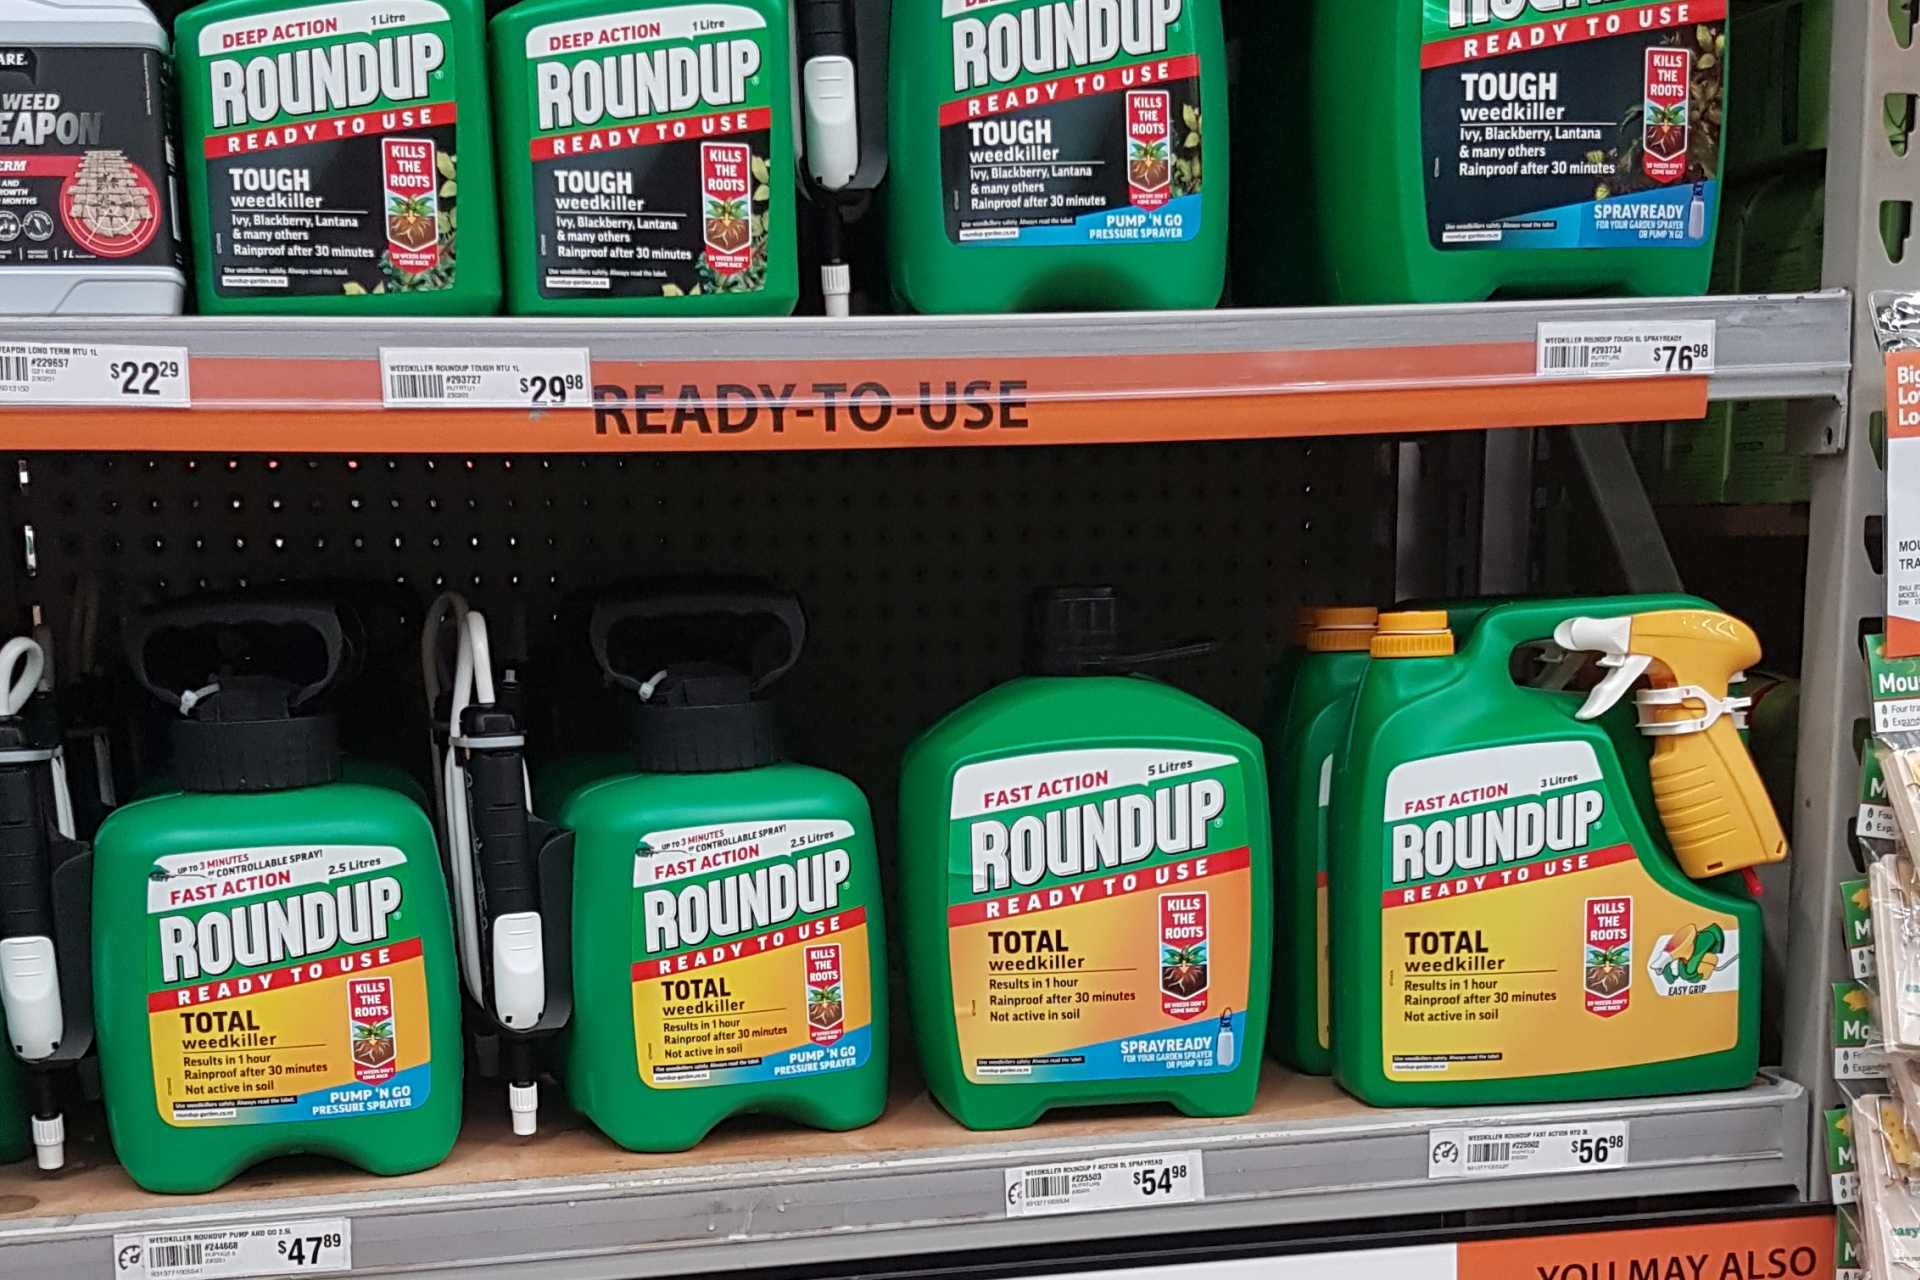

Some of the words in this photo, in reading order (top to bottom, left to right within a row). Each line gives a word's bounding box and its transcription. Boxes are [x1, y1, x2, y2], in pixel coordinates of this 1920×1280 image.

[371, 16, 376, 25] 1
[379, 14, 405, 24] Litre
[693, 22, 698, 31] 1
[700, 20, 725, 31] Litre
[223, 29, 268, 48] DEEP
[272, 18, 337, 41] ACTION
[550, 32, 593, 51] DEEP
[598, 22, 660, 44] ACTION
[1464, 23, 1567, 58] READY
[1587, 15, 1620, 36] TO
[1639, 5, 1689, 28] USE
[953, 0, 1181, 92] ROUNDUP
[1654, 55, 1682, 68] KILLS
[210, 33, 444, 128] ROUNDUP
[1658, 70, 1678, 82] THE
[537, 39, 760, 131] ROUNDUP
[968, 82, 1058, 116] READY
[1075, 75, 1105, 94] TO
[1122, 62, 1168, 85] USE
[1461, 72, 1556, 101] TOUGH
[1650, 84, 1684, 96] ROOTS
[2, 94, 60, 110] WEED
[1133, 97, 1162, 108] KILLS
[1138, 110, 1158, 121] THE
[1461, 102, 1564, 120] weedkiller
[228, 124, 317, 153] READY
[334, 118, 365, 136] TO
[383, 109, 431, 128] USE
[554, 129, 640, 154] READY
[656, 122, 685, 140] TO
[702, 113, 748, 133] USE
[969, 120, 1051, 146] TOUGH
[1132, 123, 1165, 134] ROOTS
[391, 145, 426, 159] KILLS
[710, 150, 741, 163] KILLS
[970, 147, 1060, 163] weedkiller
[397, 160, 421, 173] THE
[715, 164, 737, 177] THE
[229, 169, 310, 192] TOUGH
[390, 175, 430, 188] ROOTS
[554, 170, 632, 195] TOUGH
[708, 178, 745, 191] ROOTS
[2, 197, 38, 205] MONTHS
[231, 193, 323, 208] weedkiller
[556, 196, 645, 211] weedkiller
[1594, 205, 1684, 219] SPRAYREADY
[232, 215, 251, 227] Ivy,
[253, 215, 314, 228] Blackberry,
[316, 216, 358, 227] Lantana
[1107, 214, 1146, 227] PUMP
[1165, 214, 1183, 225] GO
[233, 230, 241, 239] &
[244, 232, 273, 242] many
[275, 230, 309, 240] others
[1089, 229, 1138, 239] PRESSURE
[1140, 227, 1182, 238] SPRAYER
[234, 245, 285, 257] Rainproof
[288, 246, 312, 256] after
[315, 246, 329, 256] 30
[332, 247, 374, 258] minutes
[594, 380, 1029, 435] READY-TO-USE
[1879, 672, 1920, 693] Mou
[1148, 765, 1155, 776] 5
[1159, 759, 1193, 773] Litres
[1540, 779, 1547, 788] 3
[1550, 774, 1578, 786] Litres
[984, 785, 1032, 809] FAST
[1038, 770, 1108, 798] ACTION
[1404, 796, 1445, 815] FAST
[1449, 783, 1508, 807] ACTION
[790, 837, 805, 848] 2.5
[808, 831, 834, 844] Litres
[971, 779, 1225, 894] ROUNDUP
[1393, 790, 1603, 884] ROUNDUP
[200, 861, 205, 870] 3
[207, 854, 249, 869] MINUTES
[217, 857, 287, 878] CONTROLLABLE
[290, 850, 323, 863] SPRAY!
[329, 863, 346, 875] 2.5
[349, 858, 381, 871] Litres
[655, 859, 696, 880] FAST
[701, 844, 759, 870] ACTION
[1404, 876, 1487, 903] READY
[1501, 869, 1529, 885] TO
[1544, 855, 1589, 876] USE
[171, 884, 218, 905] FAST
[222, 870, 291, 895] ACTION
[987, 885, 1085, 918] READY
[1104, 876, 1136, 896] TO
[1155, 859, 1208, 884] USE
[644, 849, 850, 954] ROUNDUP
[1167, 899, 1201, 911] KILLS
[1593, 903, 1625, 915] KILLS
[1172, 913, 1195, 924] THE
[1598, 916, 1620, 928] THE
[160, 877, 401, 983] ROUNDUP
[1165, 926, 1204, 939] ROOTS
[1590, 929, 1627, 941] ROOTS
[659, 943, 743, 974] READY
[758, 933, 784, 949] TO
[799, 916, 840, 939] USE
[988, 929, 1069, 955] TOTAL
[1405, 930, 1488, 955] TOTAL
[811, 949, 835, 960] KILLS
[815, 960, 832, 970] THE
[989, 955, 1085, 971] weedkiller
[1405, 956, 1505, 972] weedkiller
[178, 976, 272, 1005] READY
[291, 965, 322, 981] TO
[340, 949, 390, 971] USE
[810, 970, 838, 982] ROOTS
[356, 982, 385, 994] KILLS
[661, 977, 731, 1000] TOTAL
[1668, 986, 1687, 996] EASY
[1689, 984, 1706, 994] GRIP
[360, 995, 381, 1005] THE
[663, 1000, 745, 1016] weedkiller
[355, 1006, 388, 1017] ROOTS
[181, 1010, 259, 1033] TOTAL
[183, 1033, 277, 1049] weedkiller
[1121, 1037, 1213, 1054] SPRAYREADY
[184, 1055, 222, 1066] Results
[225, 1054, 236, 1065] in
[239, 1054, 243, 1064] 1
[247, 1053, 271, 1063] hour
[1630, 1255, 1708, 1280] MAY
[1720, 1246, 1816, 1280] ALSO
